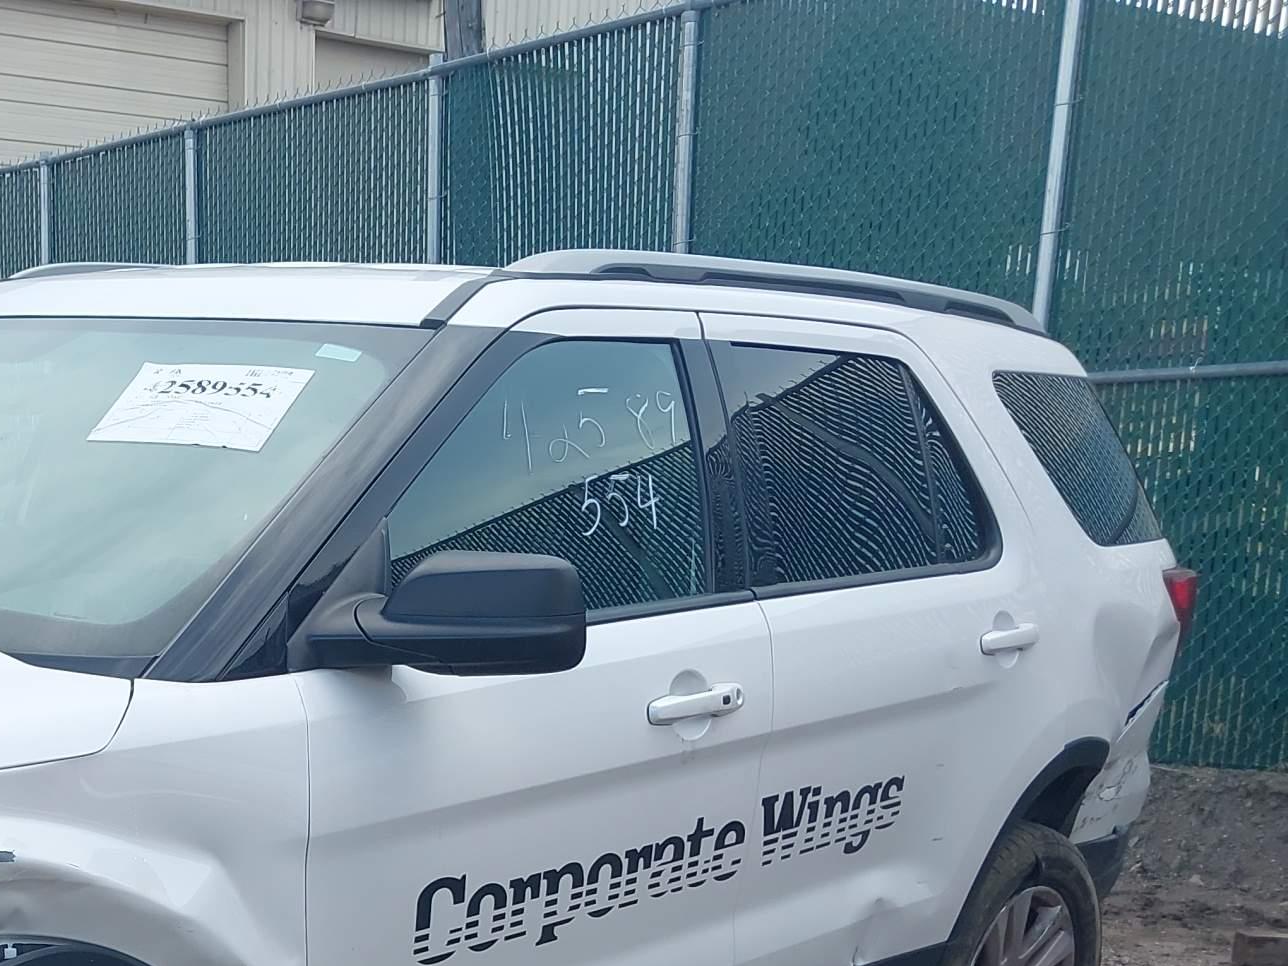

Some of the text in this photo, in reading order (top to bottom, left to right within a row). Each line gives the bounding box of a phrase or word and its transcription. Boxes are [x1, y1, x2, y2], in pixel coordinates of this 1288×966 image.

[580, 474, 660, 536] 554
[413, 775, 906, 966] Corporate Wings
